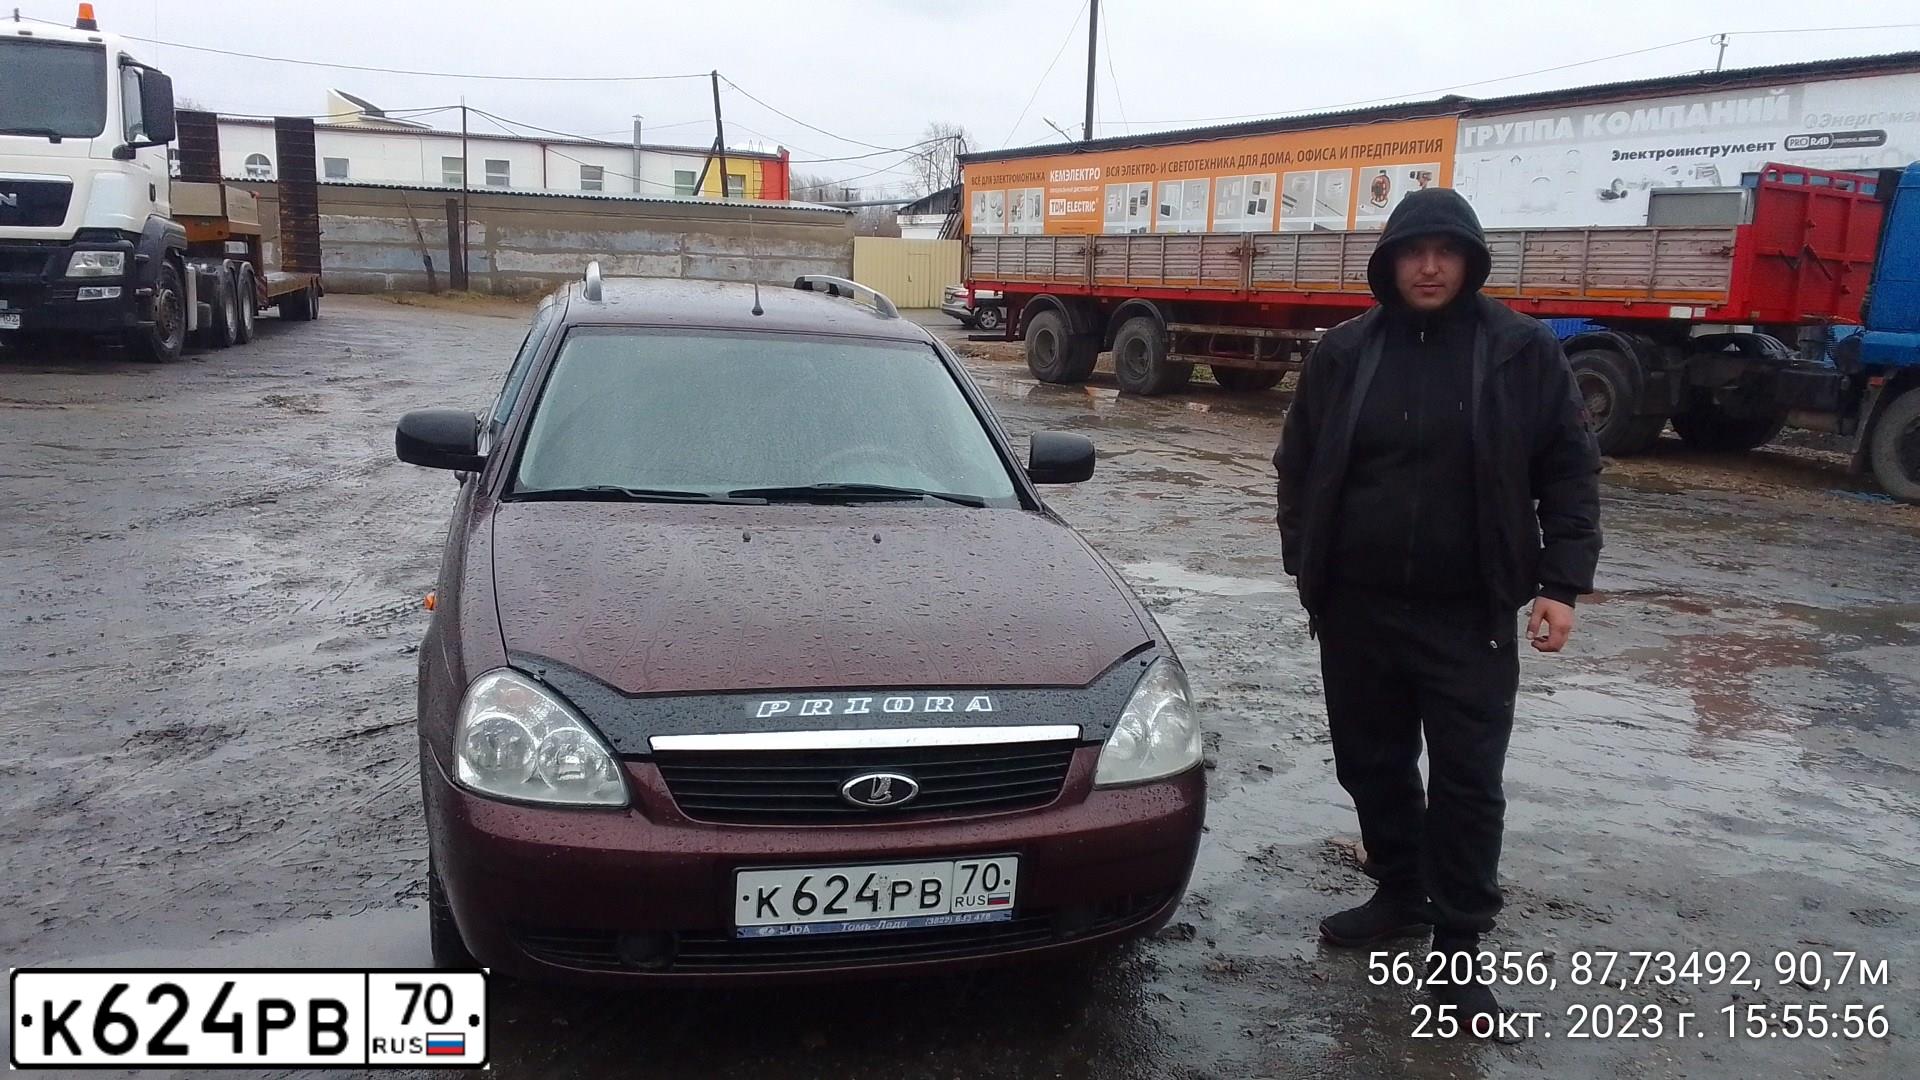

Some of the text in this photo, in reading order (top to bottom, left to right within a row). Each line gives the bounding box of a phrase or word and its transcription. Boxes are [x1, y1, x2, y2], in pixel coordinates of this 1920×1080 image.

[1464, 88, 1790, 147] ГРУППА КОМПАНИЙ
[1106, 164, 1123, 178] ВСЯ
[1160, 160, 1167, 174] И
[1168, 155, 1236, 173] СВЕТОТЕХНИКА
[1237, 153, 1258, 170] ДЛЯ
[1260, 150, 1294, 166] ДОМА,
[1297, 147, 1336, 162] ОФИСА
[1340, 145, 1348, 159] И
[1350, 138, 1444, 160] ПРЕДПРИЯТИЯ
[1611, 140, 1777, 162] Электроинструмент
[1050, 168, 1100, 182] КЕМЭЛЕКТРО
[1066, 200, 1096, 213] ELECTRIC
[756, 695, 993, 718] PRIORA
[959, 862, 1001, 894] 70
[954, 895, 986, 908] RUS
